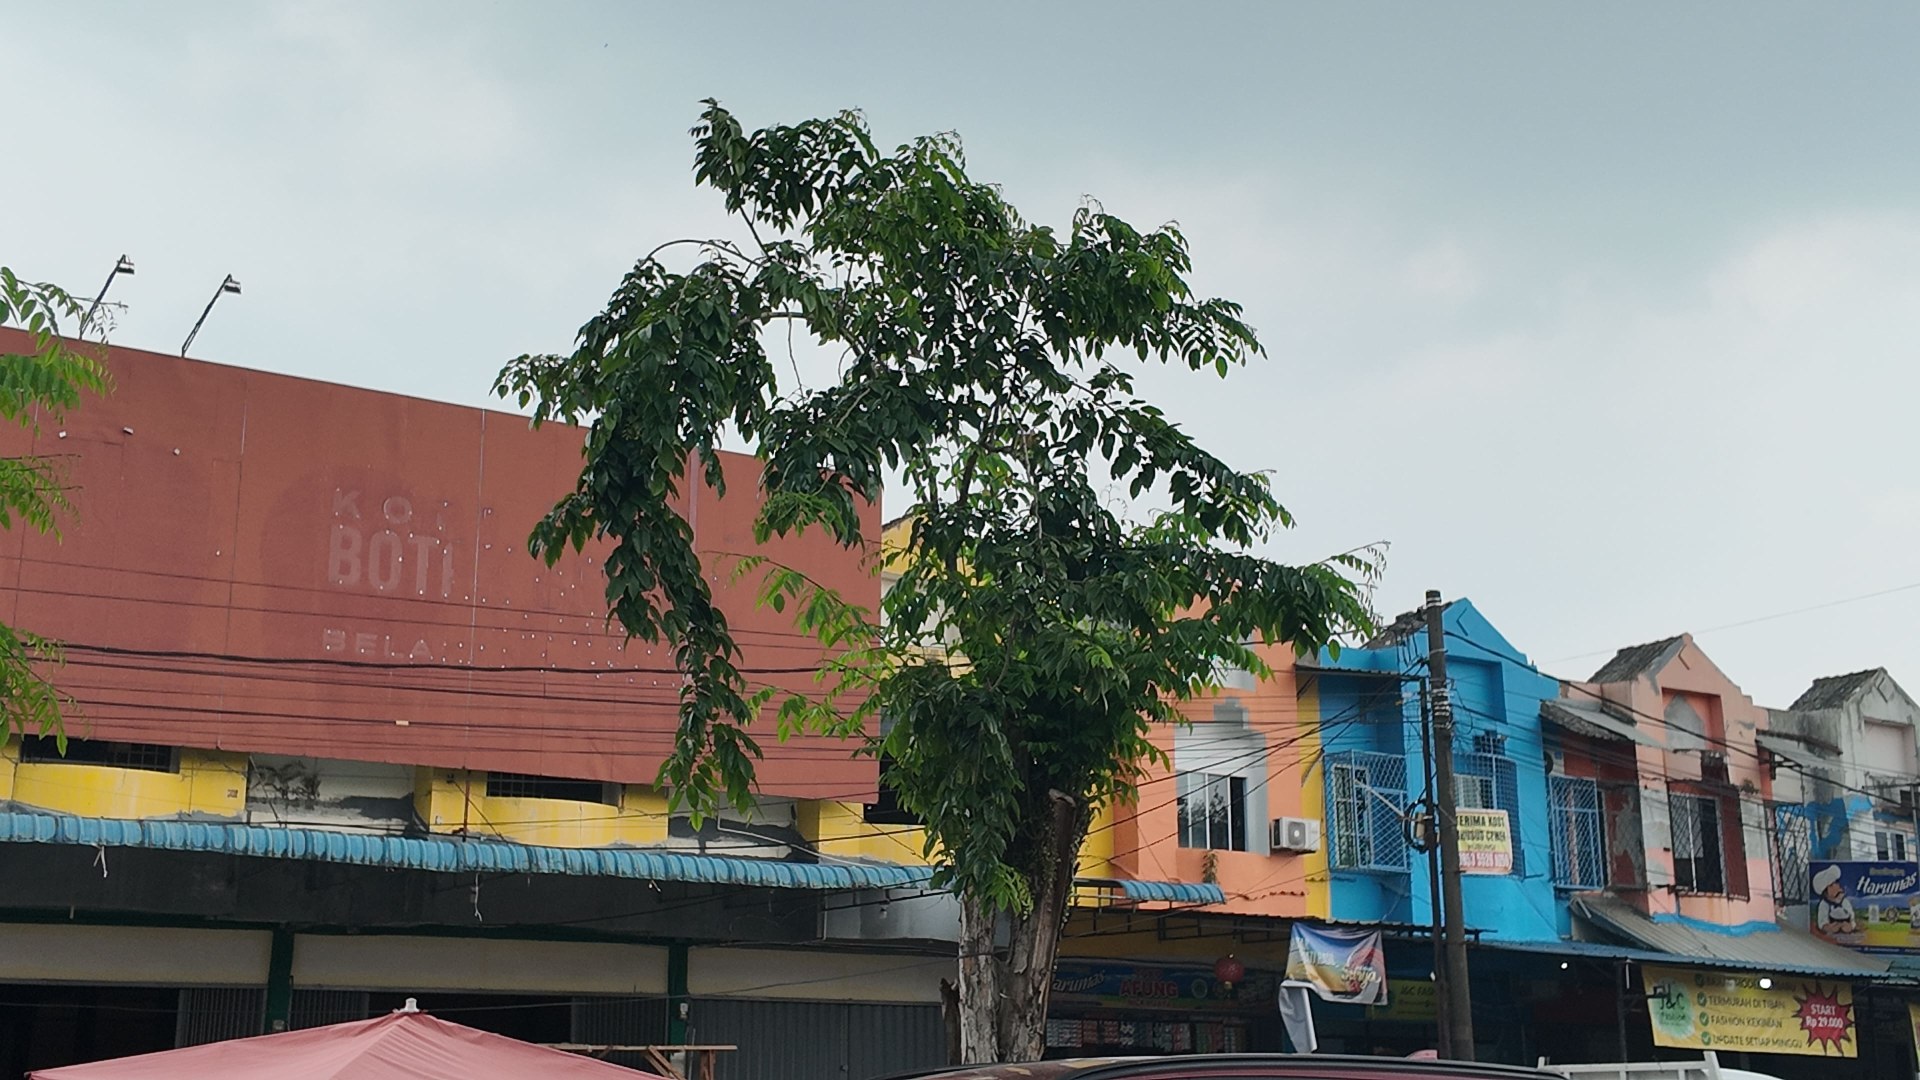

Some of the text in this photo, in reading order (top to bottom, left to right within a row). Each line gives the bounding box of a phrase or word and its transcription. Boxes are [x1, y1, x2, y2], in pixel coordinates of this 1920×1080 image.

[1856, 872, 1917, 896] Harumas
[1810, 1003, 1836, 1015] START
[1711, 1014, 1746, 1025] FASHION
[1805, 1015, 1844, 1028] Rp 29.000
[1713, 1034, 1744, 1045] UPDATE
